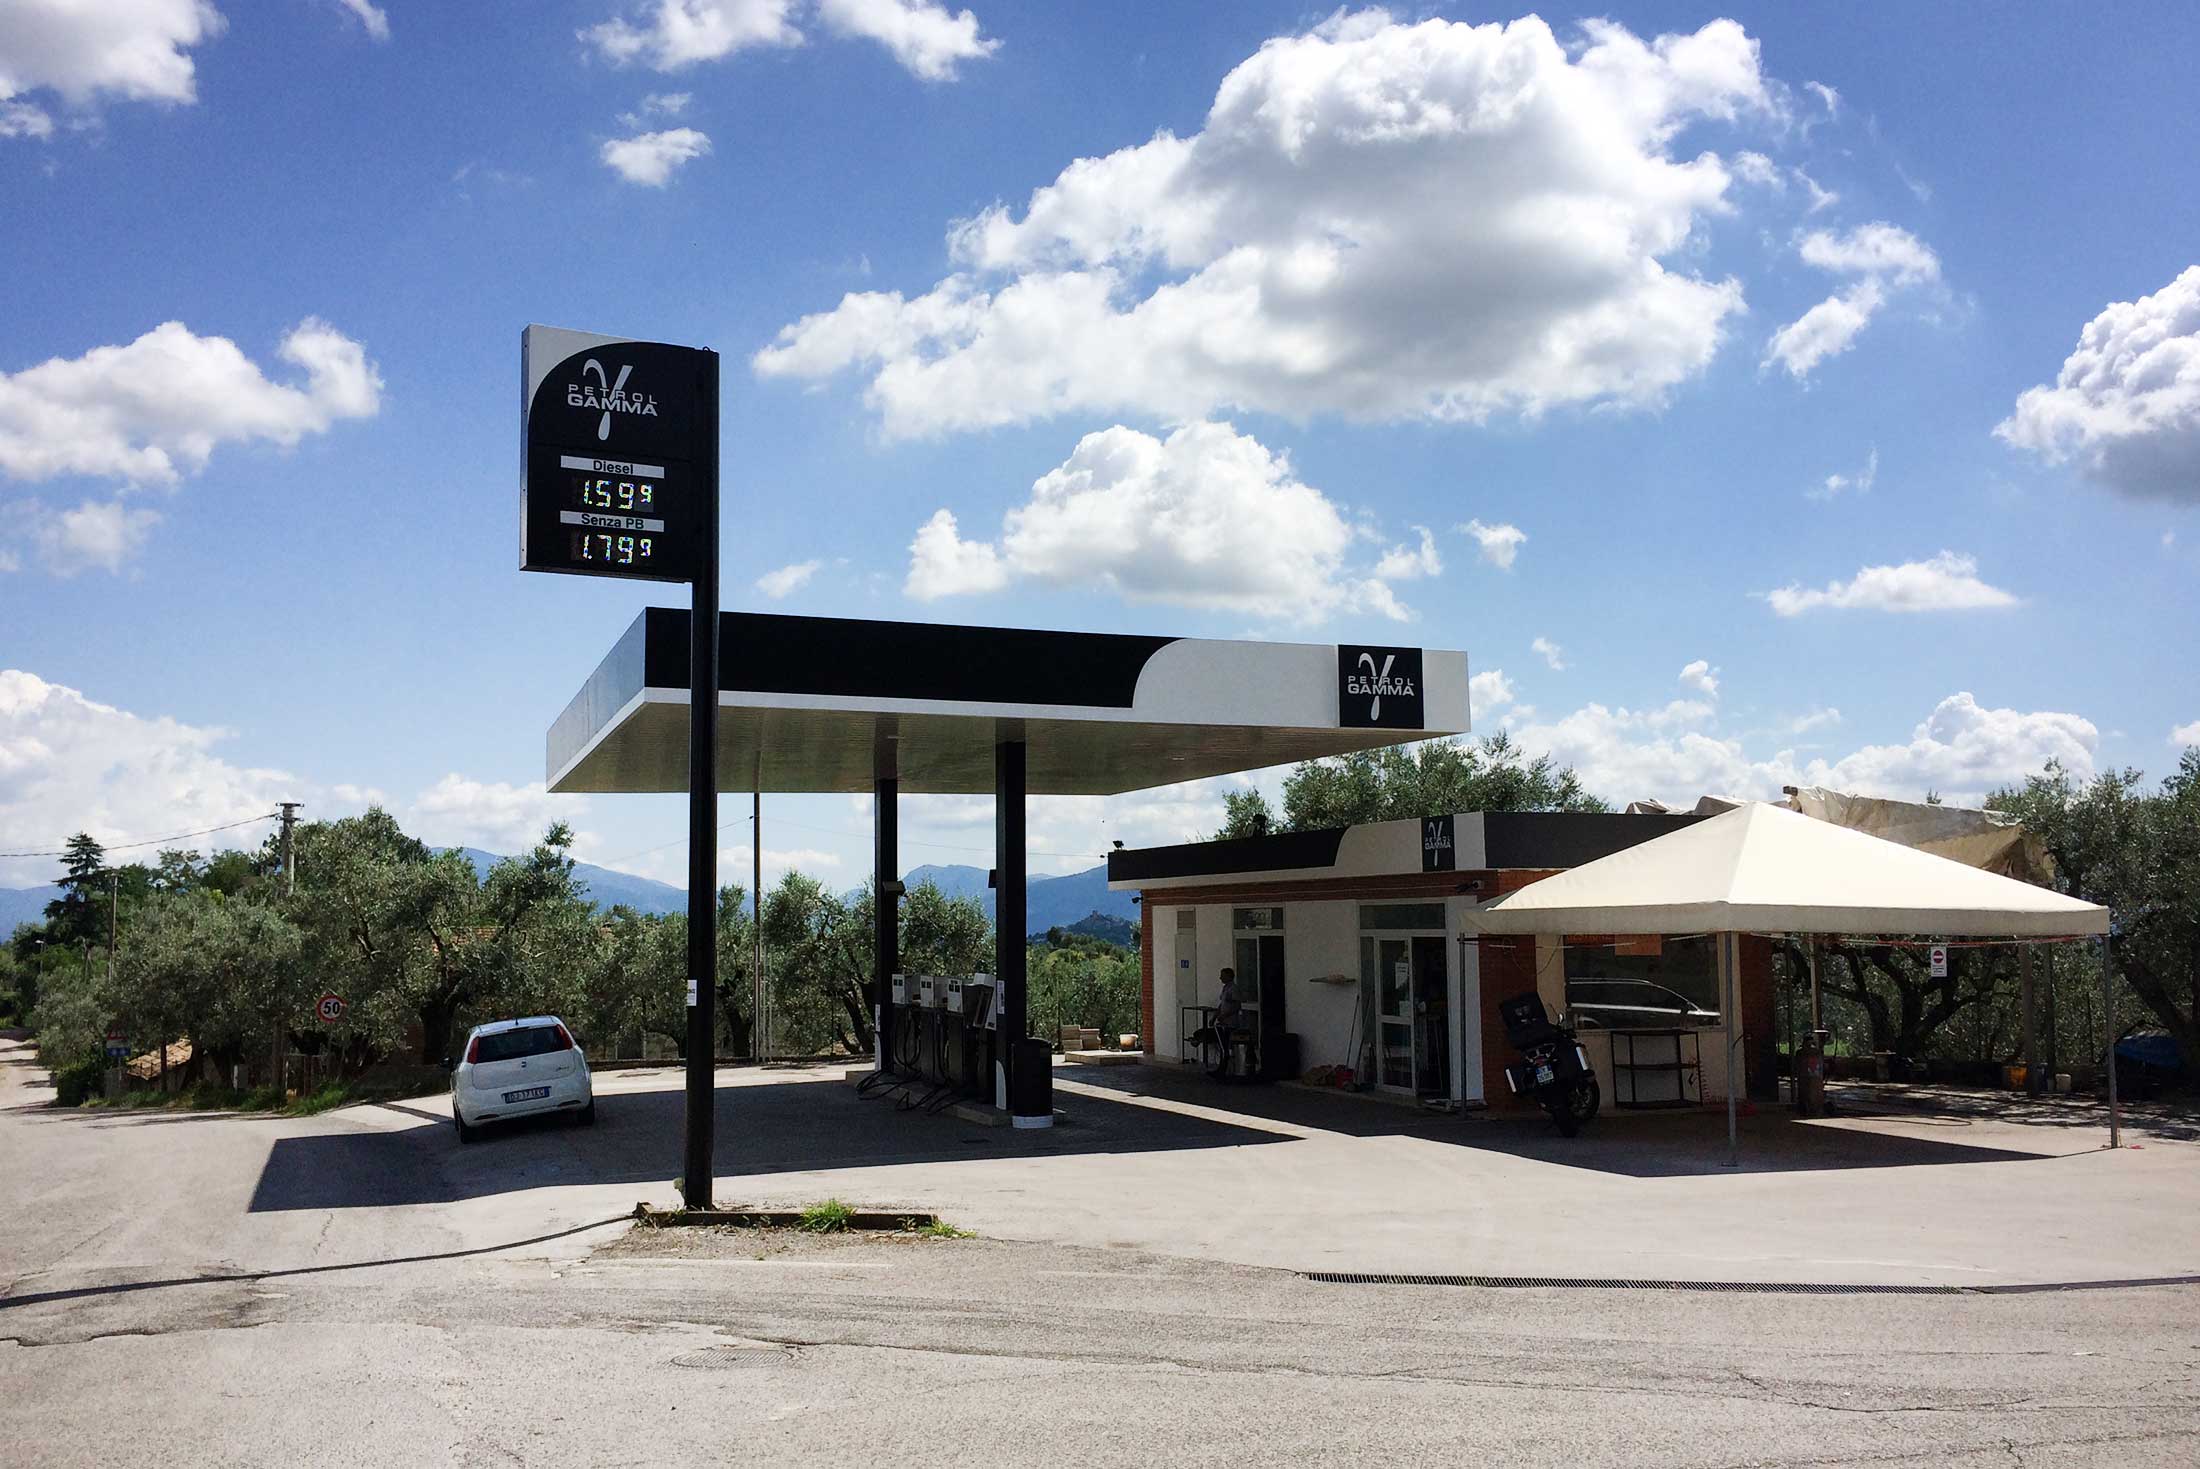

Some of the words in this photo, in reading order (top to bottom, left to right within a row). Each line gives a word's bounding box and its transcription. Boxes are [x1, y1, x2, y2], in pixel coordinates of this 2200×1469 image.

[568, 384, 657, 405] PETROL
[567, 393, 658, 417] GAMMA
[593, 460, 634, 475] Diesel
[581, 513, 621, 528] Senza
[626, 518, 644, 530] PB
[1348, 675, 1414, 686] PETROL
[1347, 683, 1415, 696] GAMMA
[323, 1001, 340, 1015] 50
